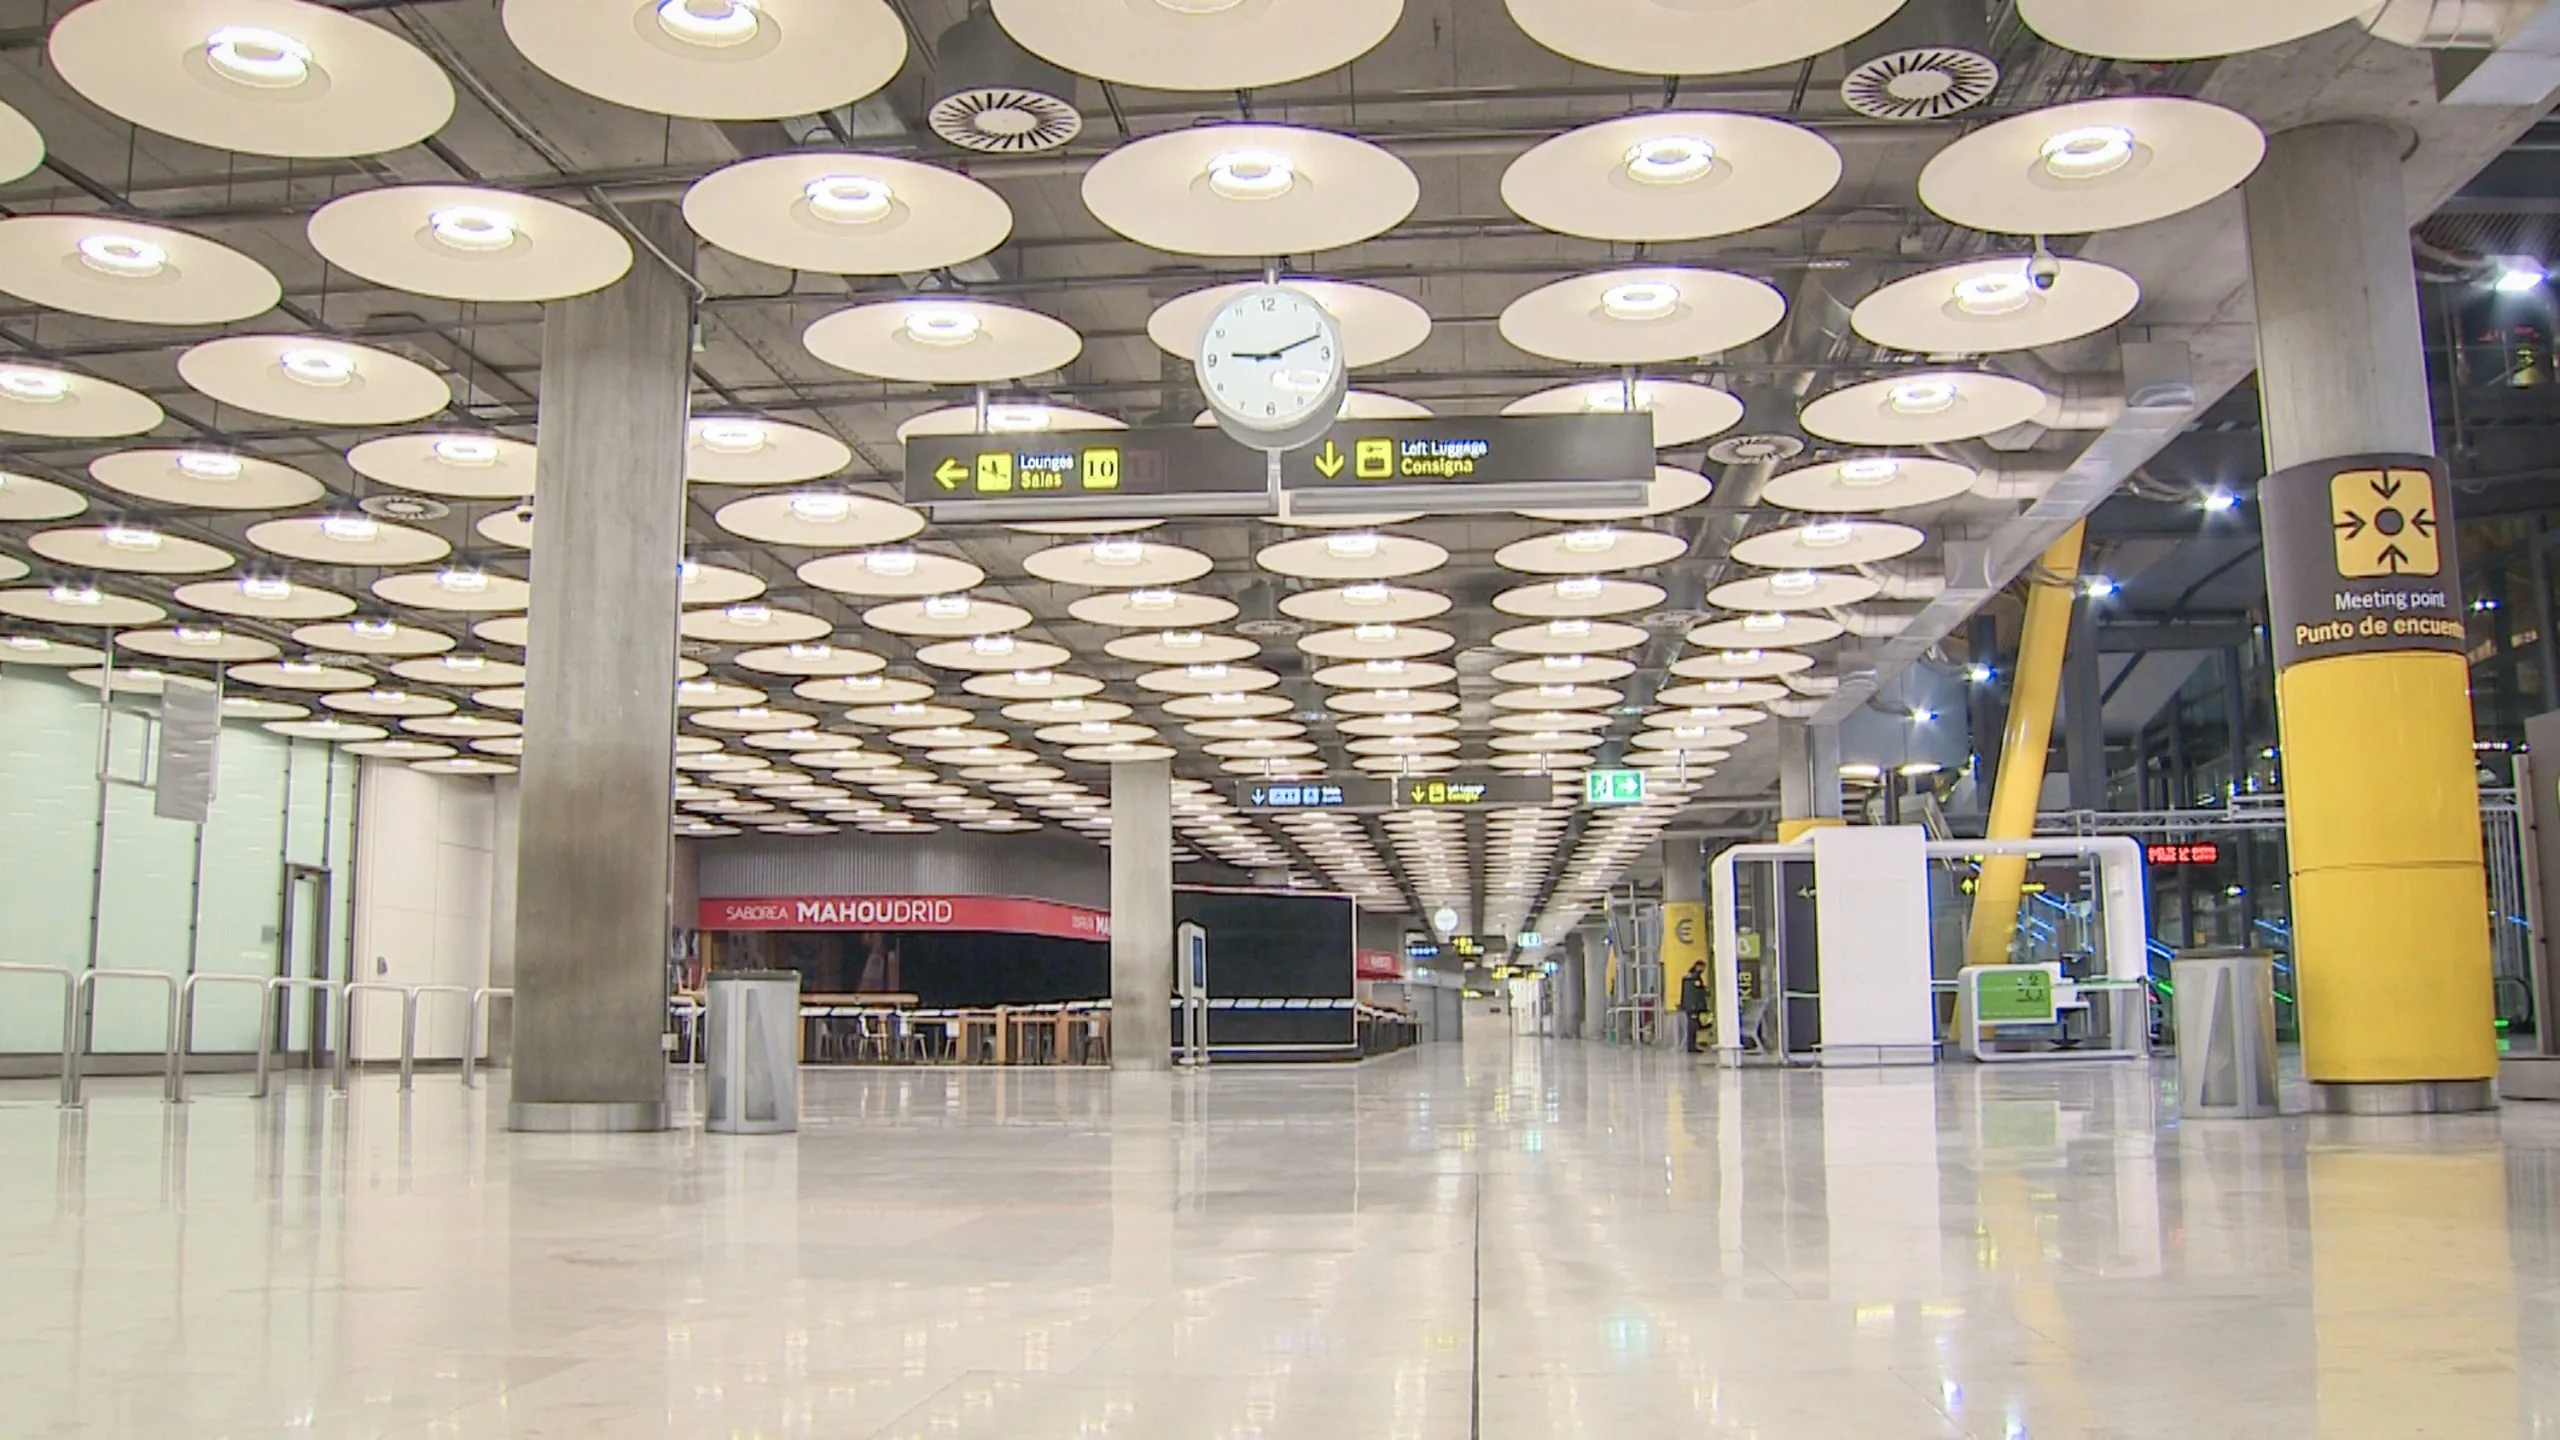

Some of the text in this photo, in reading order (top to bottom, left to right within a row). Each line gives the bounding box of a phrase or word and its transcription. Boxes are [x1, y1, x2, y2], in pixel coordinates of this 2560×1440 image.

[1260, 298, 1276, 312] 12
[1215, 328, 1226, 338] 10
[1208, 354, 1217, 367] 9
[1321, 347, 1331, 360] 3
[1266, 403, 1276, 416] 6
[1400, 441, 1488, 459] Left Luggage
[1019, 454, 1075, 471] Lounges
[1087, 460, 1114, 479] 10
[1400, 458, 1474, 478] Consigna
[1020, 471, 1063, 489] Sales
[2334, 588, 2446, 611] Meeting point
[2295, 620, 2354, 645] Punto
[2359, 616, 2389, 636] de
[725, 900, 953, 923] SABOREA MAHOUDRID
